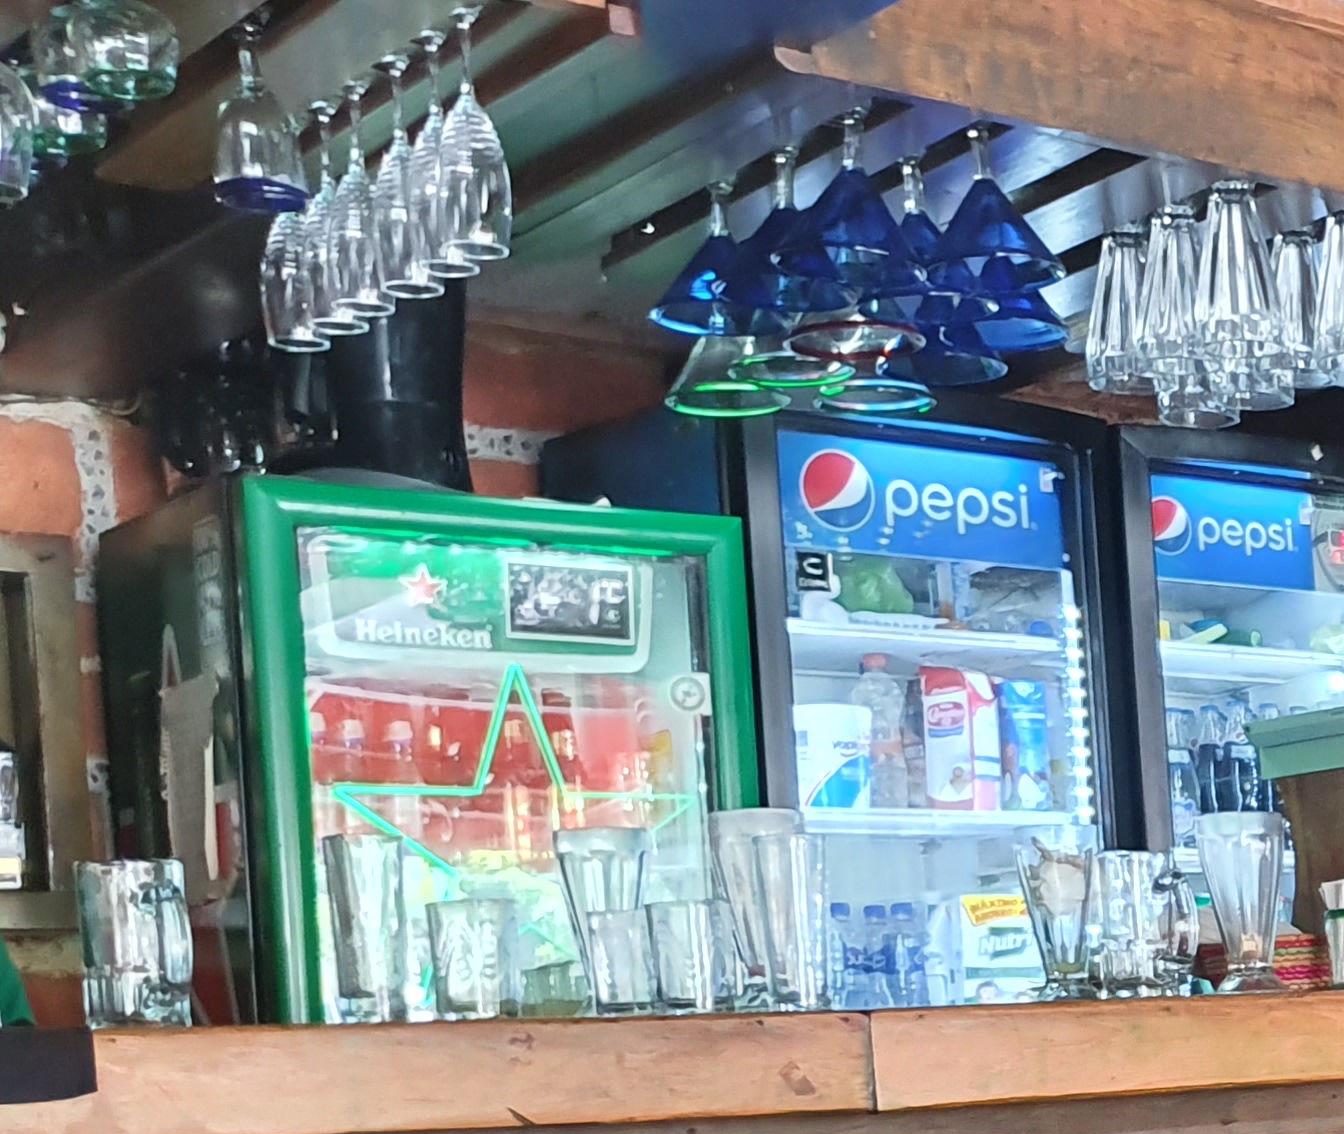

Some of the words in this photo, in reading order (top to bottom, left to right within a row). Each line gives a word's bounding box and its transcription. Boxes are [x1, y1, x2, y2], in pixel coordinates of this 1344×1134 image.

[884, 477, 1031, 536] pepsi
[1197, 516, 1294, 557] pepsi
[354, 617, 493, 650] Heineken
